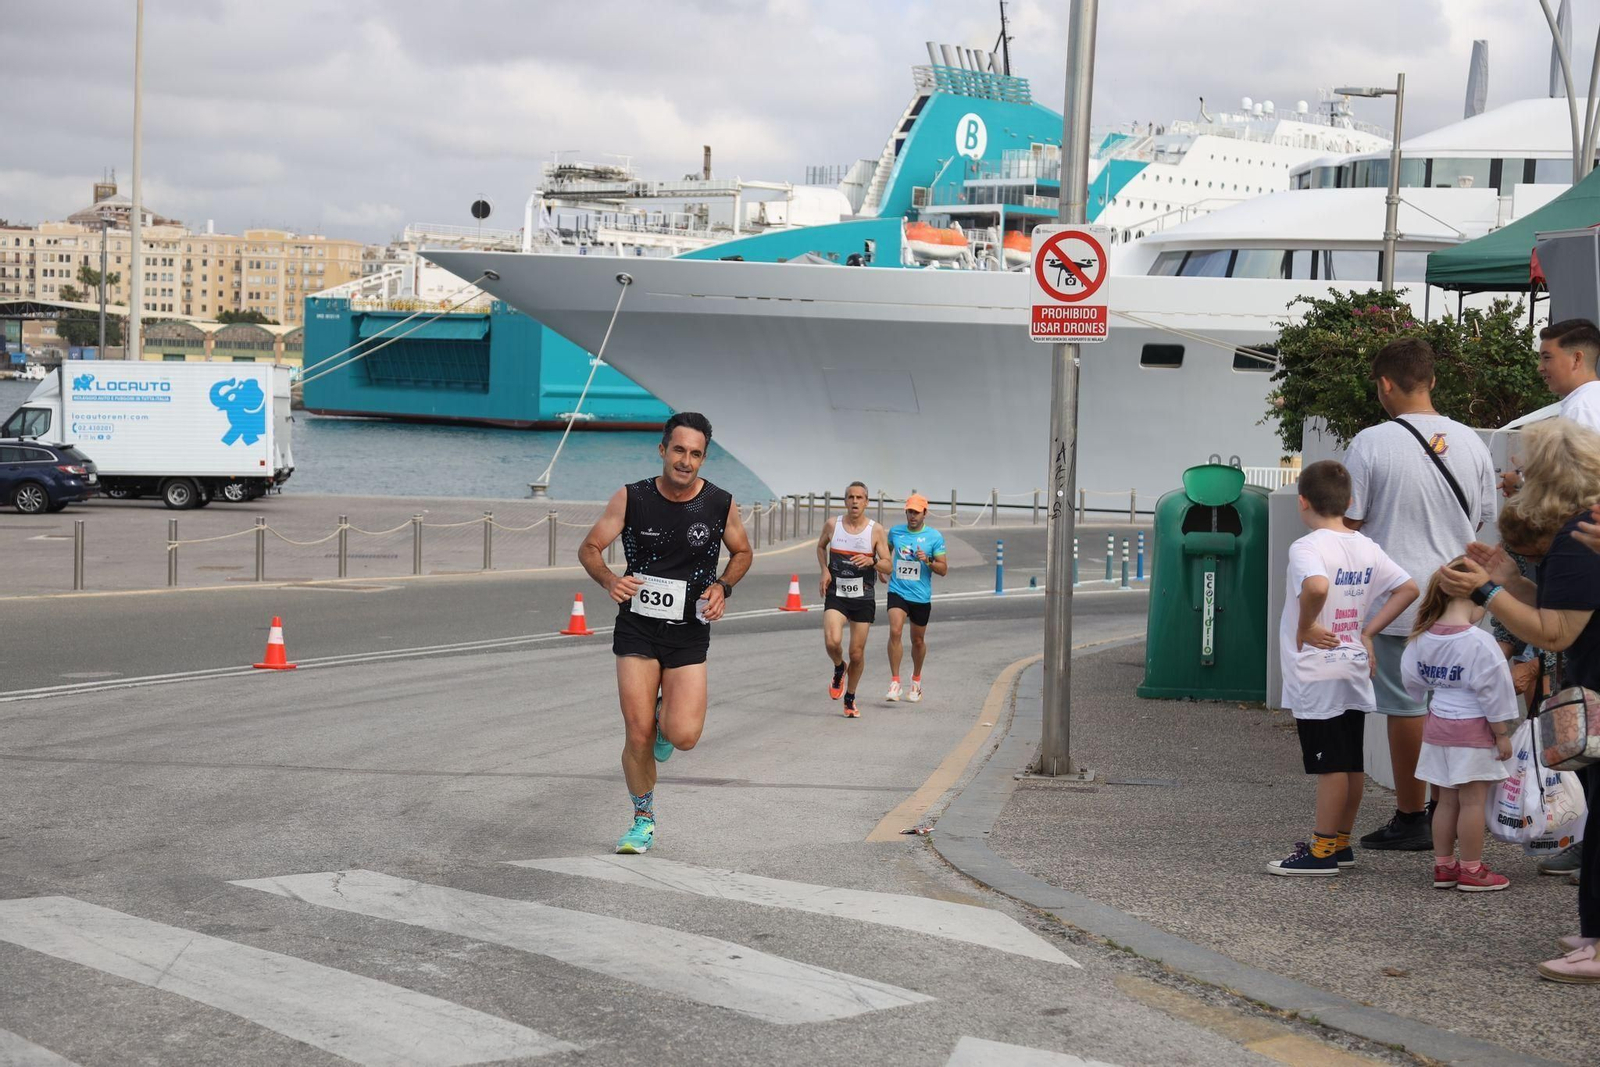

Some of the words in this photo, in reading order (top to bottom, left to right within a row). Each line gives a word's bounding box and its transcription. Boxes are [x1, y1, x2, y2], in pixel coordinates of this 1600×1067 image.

[965, 120, 978, 150] B
[1041, 307, 1097, 319] PROHIBIDO
[1033, 322, 1060, 333] USAR
[1063, 322, 1105, 333] DRONES
[96, 381, 171, 391] LOCAUTO
[72, 412, 149, 420] locautorent.com
[898, 566, 918, 575] 1271
[841, 584, 859, 592] 596
[640, 589, 674, 608] 630
[1204, 574, 1214, 654] ecovidrio
[1449, 666, 1465, 681] 5K
